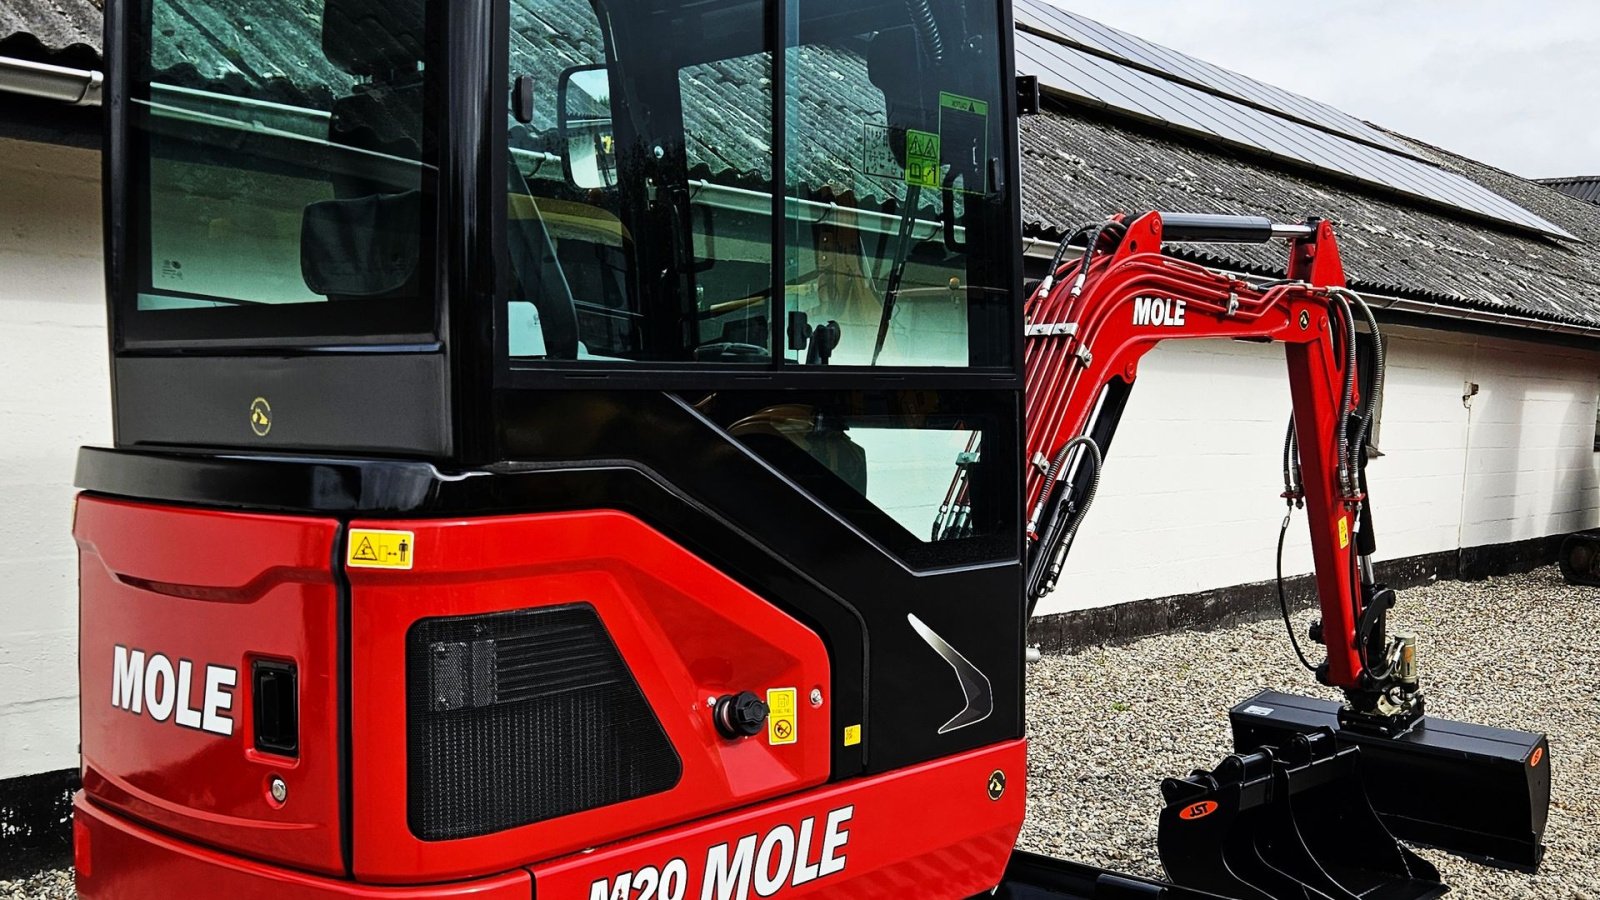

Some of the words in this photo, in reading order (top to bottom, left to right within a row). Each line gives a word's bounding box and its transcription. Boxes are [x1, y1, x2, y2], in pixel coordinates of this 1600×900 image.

[1132, 297, 1187, 327] MOLE
[111, 645, 237, 736] MOLE
[1190, 802, 1208, 817] JST
[588, 857, 689, 900] M20
[700, 805, 855, 900] MOLE
